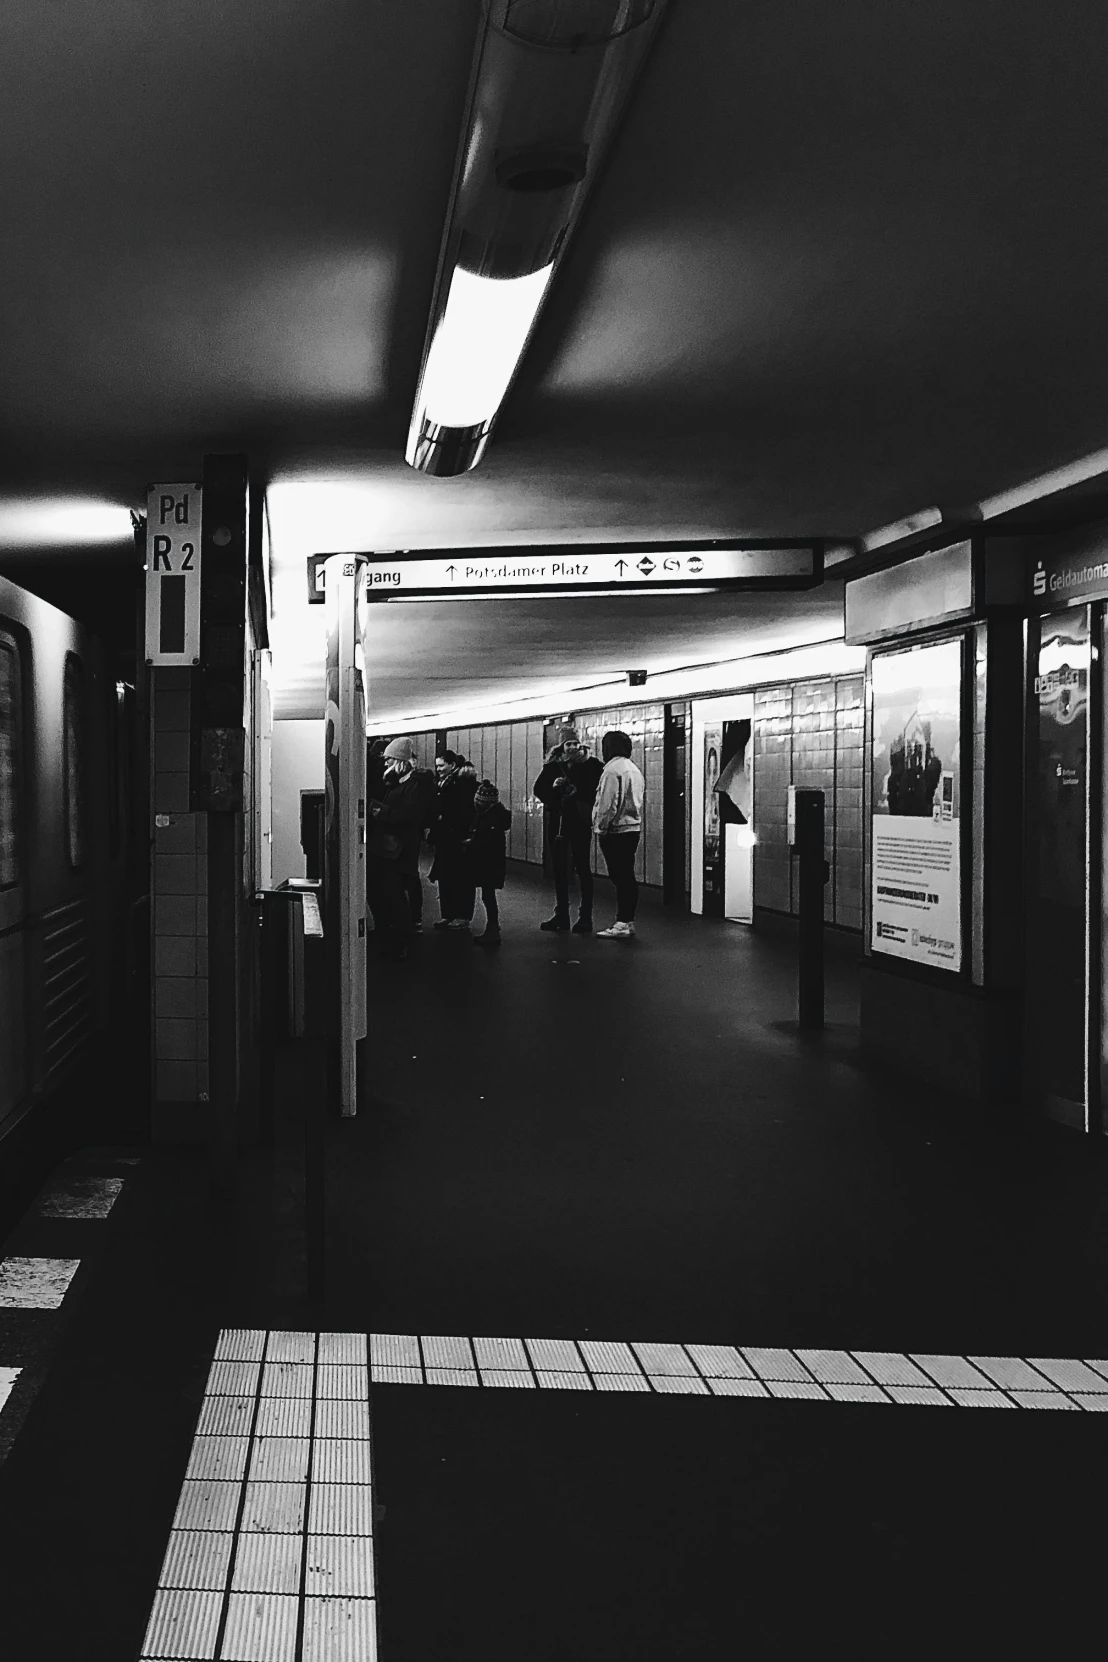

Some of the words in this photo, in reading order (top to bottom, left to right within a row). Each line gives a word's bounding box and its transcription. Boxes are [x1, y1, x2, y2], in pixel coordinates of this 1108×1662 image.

[159, 494, 189, 525] Pd
[152, 534, 172, 572] R
[181, 542, 194, 571] 2
[366, 571, 401, 587] gang
[465, 564, 546, 578] Potsdamer
[552, 562, 589, 576] Platz
[1049, 563, 1108, 591] Geldautoma
